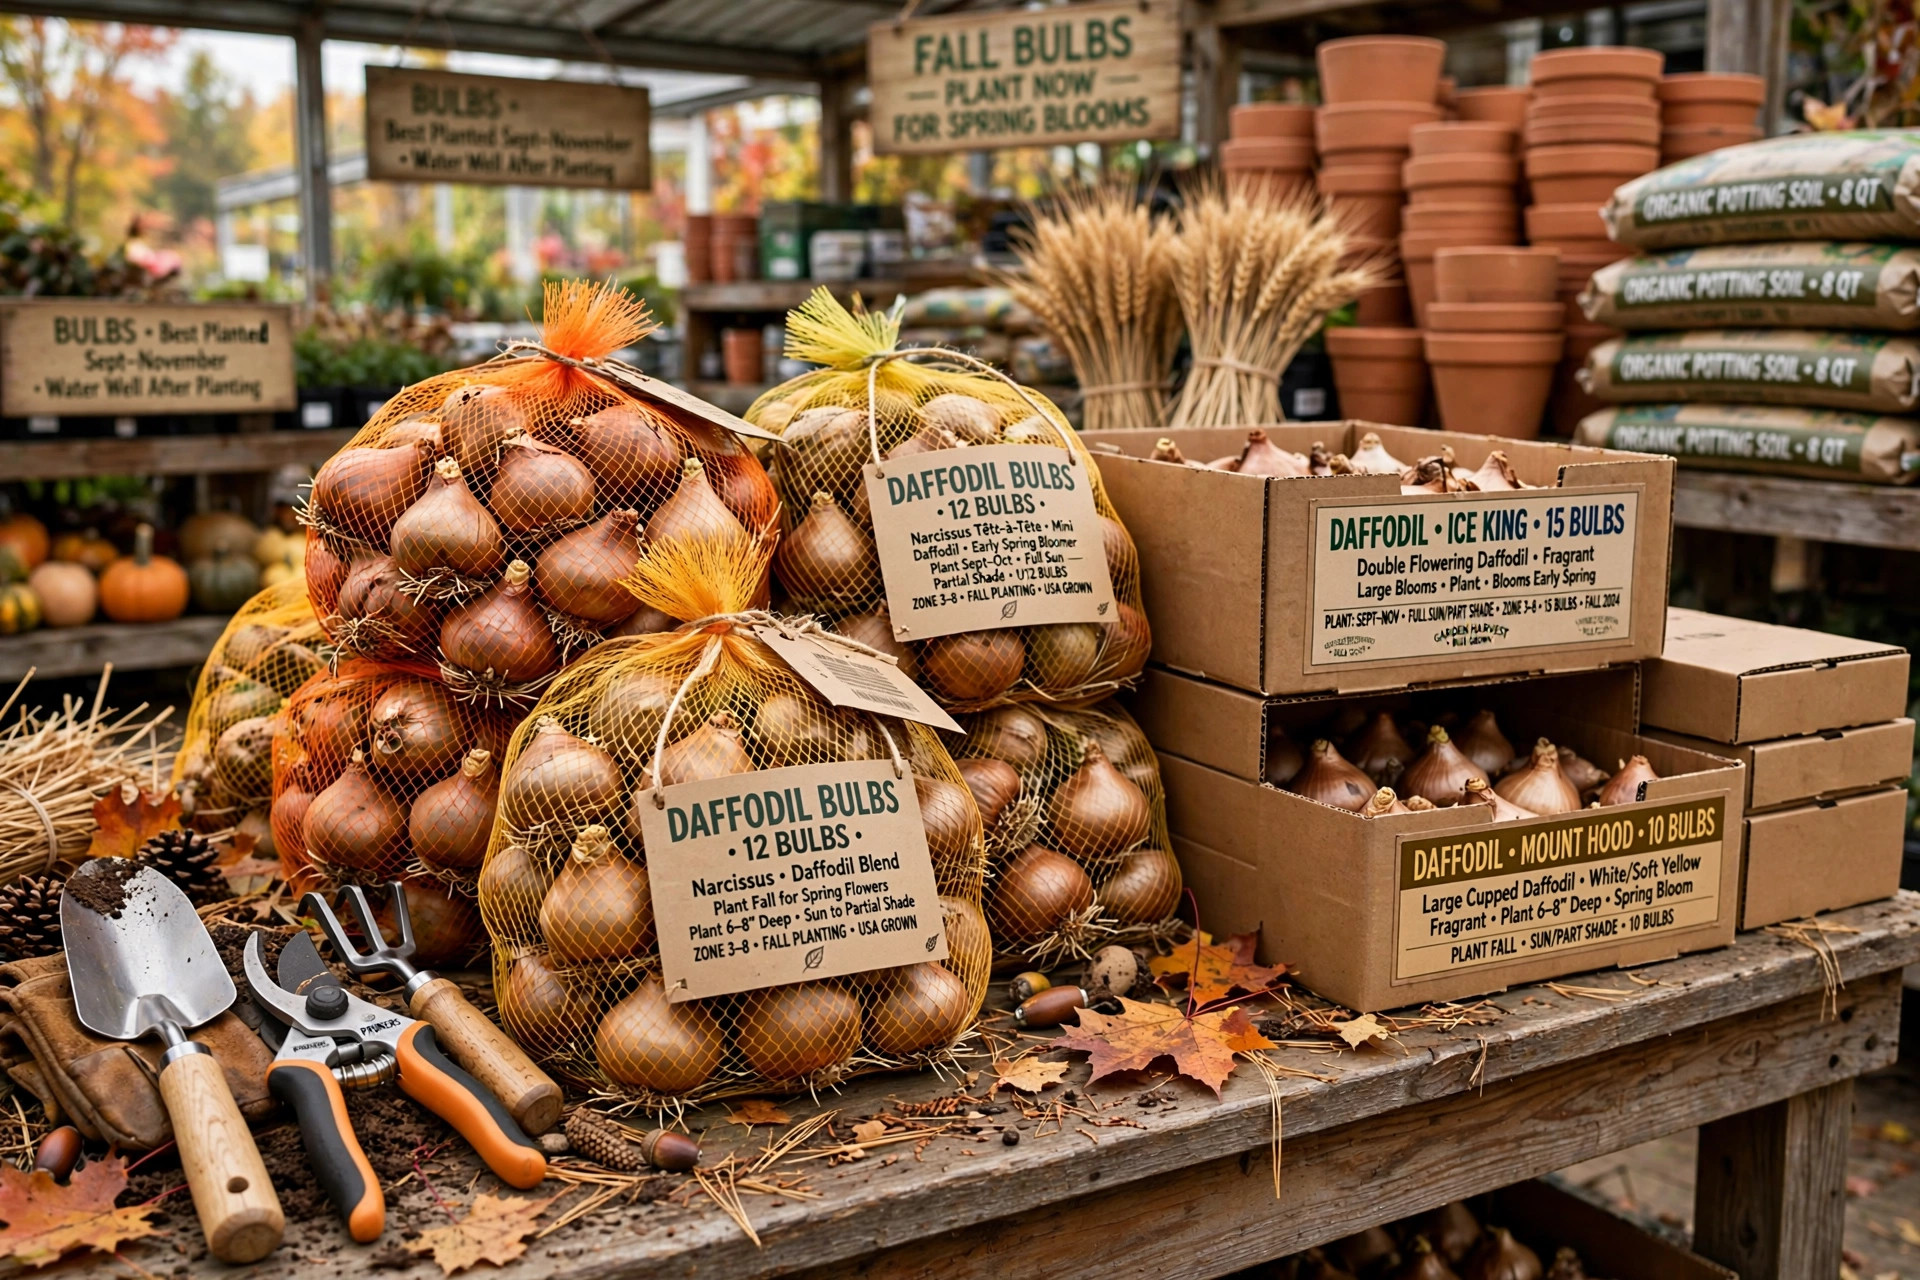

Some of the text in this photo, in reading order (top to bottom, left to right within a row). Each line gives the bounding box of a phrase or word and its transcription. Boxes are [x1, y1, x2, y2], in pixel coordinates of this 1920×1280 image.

[913, 16, 1132, 75] FALL BULBS
[411, 82, 500, 117] BULBS
[945, 69, 1097, 105] PLANT NOW
[385, 120, 425, 143] Best
[430, 122, 496, 146] Planted
[893, 97, 1150, 142] FOR SPRING BLOOMS
[411, 150, 614, 181] Water Well After Planting
[1642, 178, 1882, 222] ORGANIC POTTING SOIL 8 QT
[1624, 270, 1864, 301] ORGANIC POTTING SOIL 8 QT
[54, 316, 269, 345] BULBS Best Planted
[84, 349, 228, 374] Sept-November
[1620, 353, 1858, 387] ORGANIC POTTING SOIL 8 QT
[45, 376, 262, 401] Water Well After Planting
[1614, 425, 1849, 466] ORGANIC POTTING SOIL 8 QT
[887, 462, 1075, 505] DAFFODIL BULBS
[949, 493, 1036, 520] 12 BULBS
[910, 529, 972, 547] Narcissus
[1051, 519, 1074, 532] Mini
[1330, 503, 1625, 551] DAFFODIL ICE KING 15 BULBS
[913, 535, 1077, 561] Daffodil Early Spring Bloomer
[930, 552, 1064, 574] Plant Sept-Oct Full Sun
[1357, 546, 1594, 576] Double Flowering Daffodil Fragrant
[912, 595, 938, 610] ZONE
[968, 588, 990, 602] FALL
[991, 584, 1036, 601] PLANTING
[1044, 582, 1062, 595] USA
[1062, 582, 1092, 594] GROWN
[933, 573, 970, 590] Partial
[972, 568, 1005, 584] Shade
[1038, 566, 1068, 579] BULBS
[1358, 568, 1596, 601] Large Blooms Plant Blooms Early Spring
[1325, 613, 1354, 629] PLANT:
[1356, 609, 1400, 627] SEPT-NOV
[1408, 608, 1427, 623] FULL
[1428, 604, 1468, 621] SUN/PART
[1469, 602, 1494, 618] SHADE
[1502, 599, 1522, 616] ZONE
[1544, 598, 1552, 612] 15
[1554, 596, 1578, 612] BULBS
[1584, 594, 1602, 610] FALL
[1603, 593, 1621, 608] 2024
[1434, 624, 1468, 642] GARDEN
[1471, 623, 1509, 638] HARVEST
[666, 780, 900, 842] DAFFODIL BULBS
[743, 823, 850, 861] 12 BULBS
[1414, 806, 1716, 881] DAFFODIL MOUNT HOOD 10 BULBS
[692, 852, 900, 898] Narcissus Daffodil Blend
[1422, 854, 1702, 914] Large Cupped Daffodil White/Soft Yellow
[713, 880, 889, 916] Plant Fall for Spring Flowers
[1430, 912, 1486, 938] Fragrant
[1500, 905, 1534, 926] Plant
[1570, 896, 1602, 914] Deep
[1614, 886, 1652, 909] Spring
[1656, 880, 1693, 899] Bloom
[688, 923, 722, 941] Plant
[758, 914, 792, 931] Deep
[804, 906, 828, 922] Sun
[830, 903, 843, 918] to
[846, 898, 881, 917] Partial
[883, 894, 916, 911] Shade
[694, 914, 918, 962] ZONE 3-8 FALL PLANTING USA GROWN
[1451, 908, 1674, 964] PLANT FALL SUN/PART SHADE 10 BULBS
